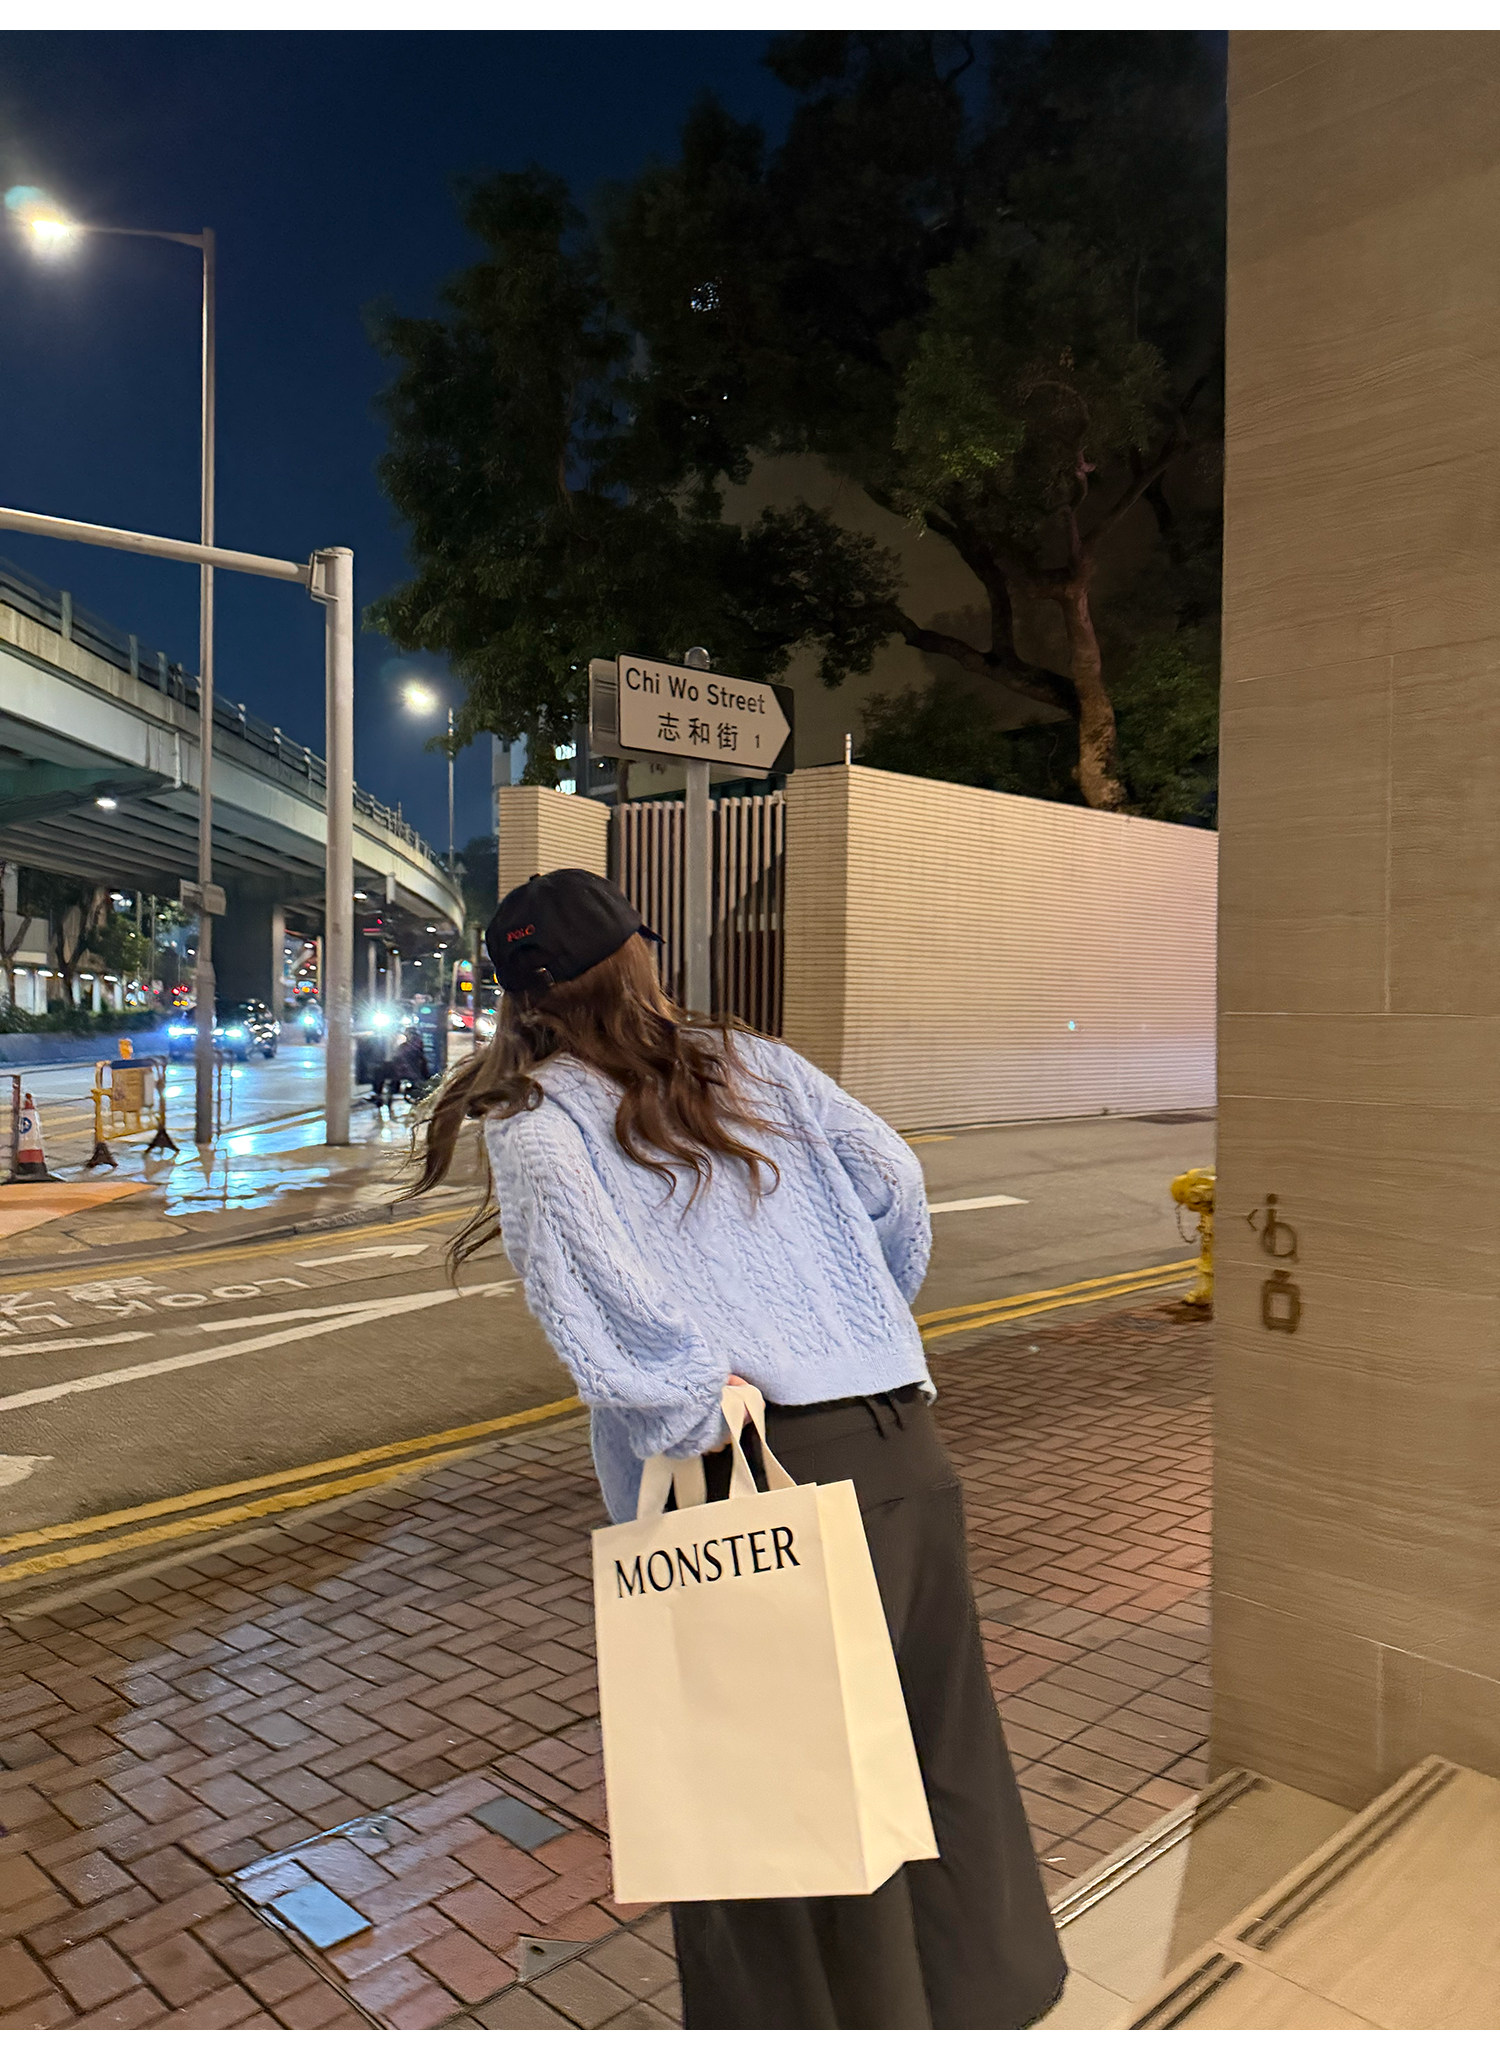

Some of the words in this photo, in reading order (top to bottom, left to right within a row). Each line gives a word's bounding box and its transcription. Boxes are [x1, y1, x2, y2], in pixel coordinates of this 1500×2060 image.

[626, 667, 660, 695] Chi
[668, 675, 699, 701] Wo
[707, 684, 766, 714] Street
[657, 712, 738, 751] 志和街
[754, 734, 761, 749] 1
[94, 1277, 311, 1318] LOOK
[614, 1526, 801, 1598] MONSTER
